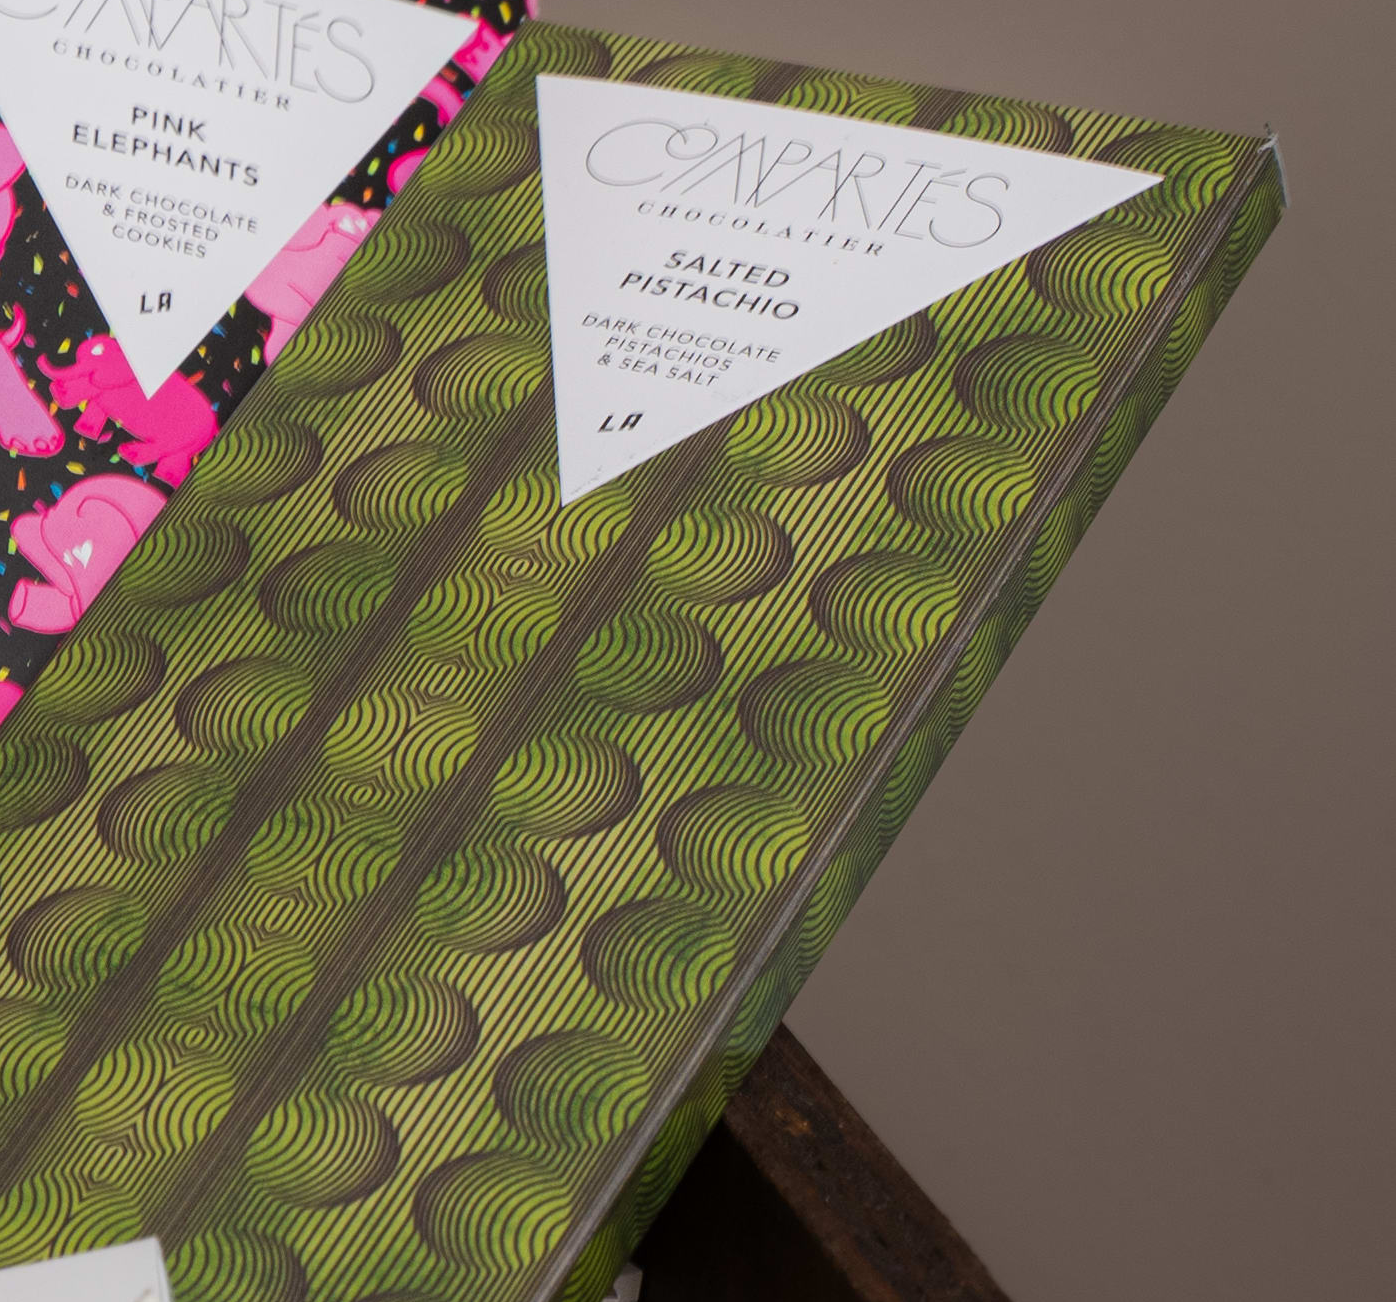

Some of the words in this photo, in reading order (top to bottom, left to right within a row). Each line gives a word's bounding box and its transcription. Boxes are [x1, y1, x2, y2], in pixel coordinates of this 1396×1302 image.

[52, 39, 291, 112] CHOCOLATIER
[131, 105, 207, 143] PINK
[72, 122, 260, 188] ELEPHANTS
[65, 174, 121, 200] DARK
[129, 189, 259, 235] CHOCOLATE
[102, 203, 115, 217] &
[124, 208, 219, 243] FROSTED
[111, 223, 207, 260] COOKIES
[636, 200, 885, 258] CHOCOLATIER
[663, 249, 792, 289] SALTED
[138, 291, 173, 315] LA
[618, 271, 801, 320] PISTACHIO
[581, 312, 640, 335] DARK
[645, 323, 782, 365] CHOCOLATE
[605, 335, 734, 373] PISTACHIOS
[596, 353, 611, 367] &
[618, 356, 659, 377] SEA
[665, 366, 721, 388] SALT
[597, 410, 644, 434] LA
